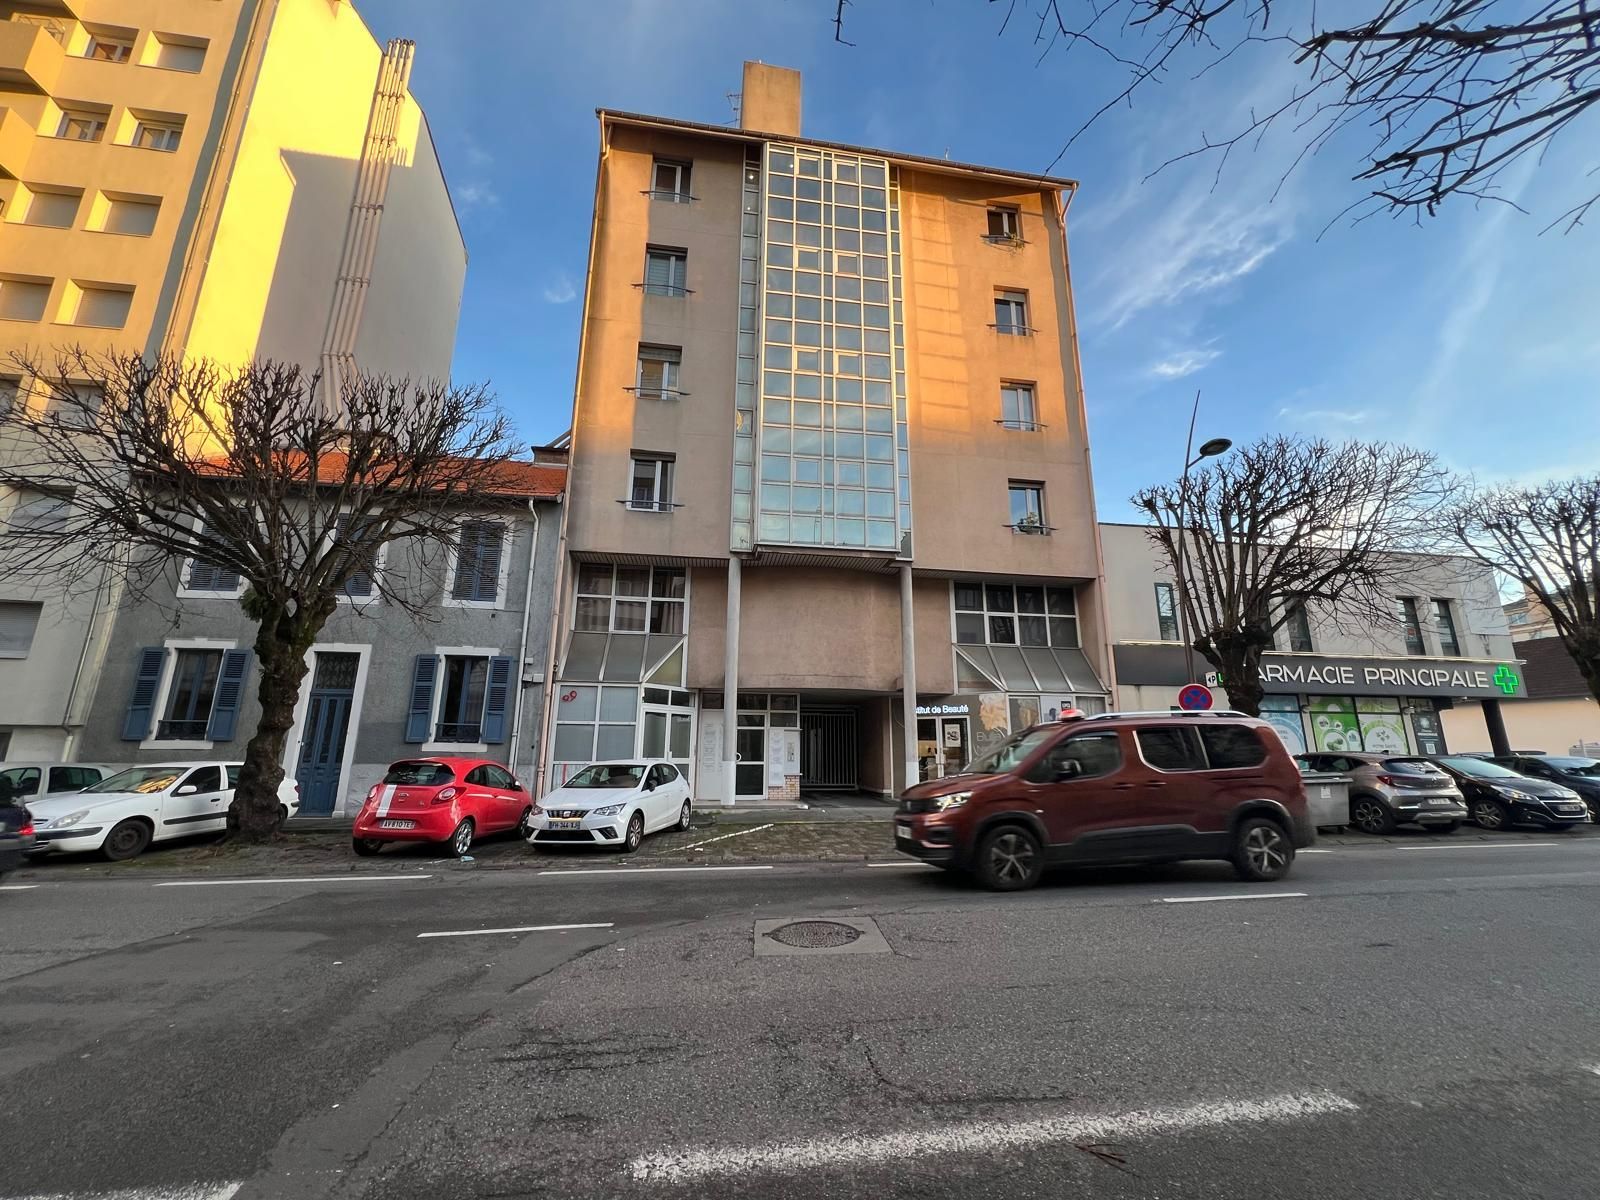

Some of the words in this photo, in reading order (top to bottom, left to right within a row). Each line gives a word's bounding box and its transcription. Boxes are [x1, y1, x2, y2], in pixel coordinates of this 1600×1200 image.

[1257, 664, 1355, 685] ARMACIE
[1363, 667, 1490, 688] PRINCIPALE
[931, 705, 942, 714] de
[942, 704, 969, 713] Beauté
